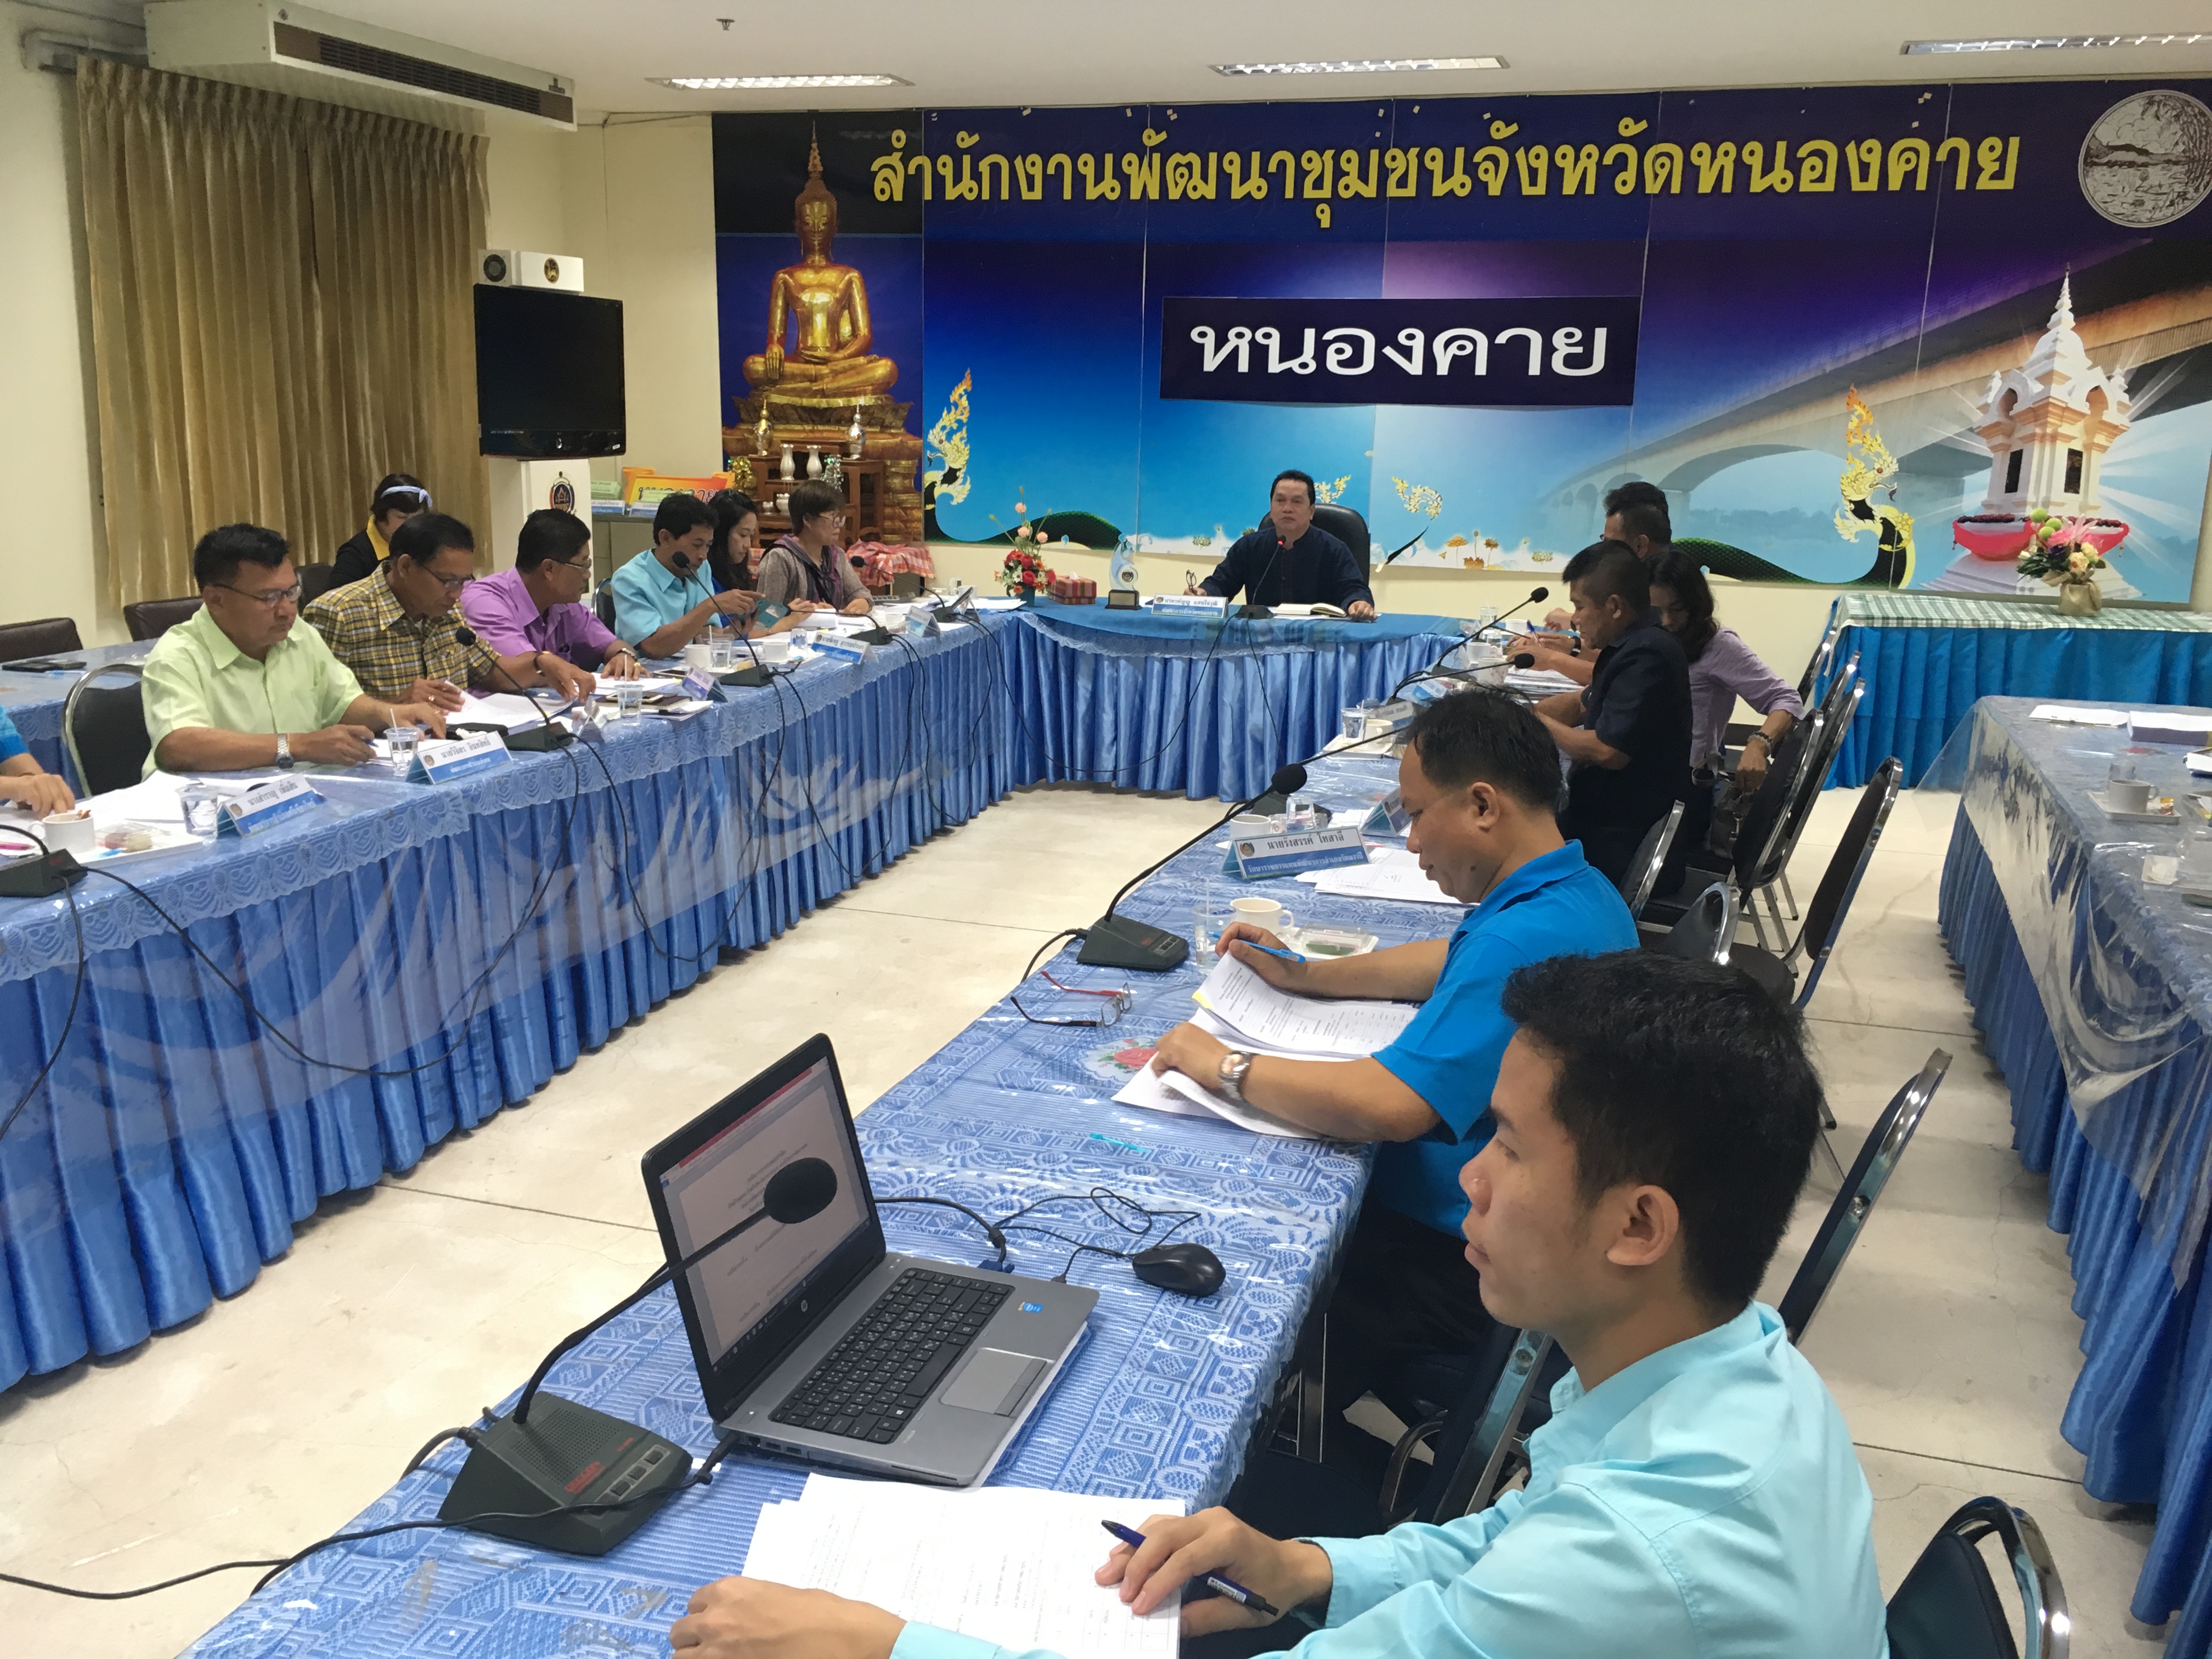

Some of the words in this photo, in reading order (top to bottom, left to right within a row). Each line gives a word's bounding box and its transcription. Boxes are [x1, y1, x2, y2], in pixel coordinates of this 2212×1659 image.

[870, 116, 2021, 229] สำนักงานพัฒนาชุมชนจังหวัดหนองคาย
[1189, 325, 1607, 377] หนองคาย
[1267, 833, 1313, 850] นายรังสรรค์
